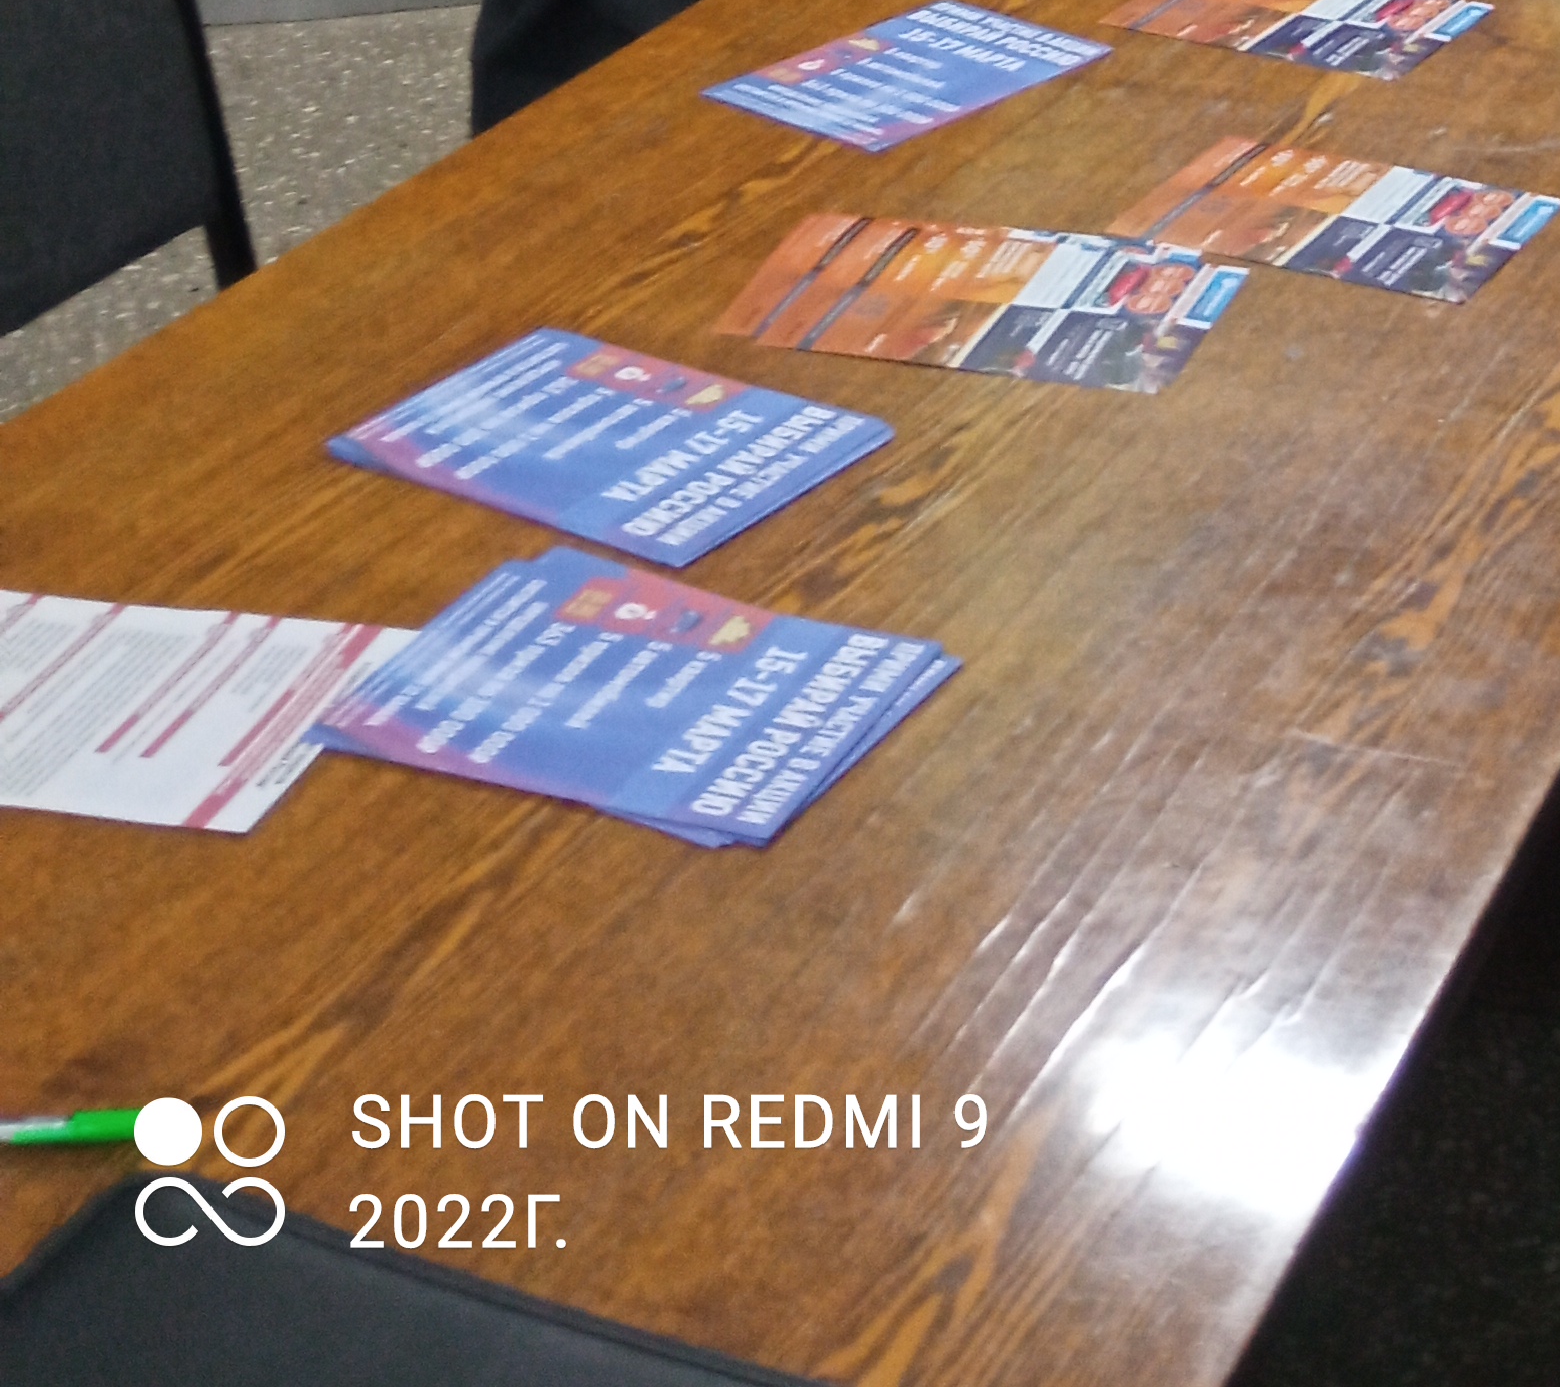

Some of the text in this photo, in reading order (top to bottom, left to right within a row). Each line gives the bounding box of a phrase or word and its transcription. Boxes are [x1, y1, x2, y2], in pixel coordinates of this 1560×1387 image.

[898, 29, 965, 50] 15-17
[953, 46, 1025, 71] МАРТА
[685, 410, 763, 454] 15-17
[717, 406, 836, 475] ВЫБИРАЙ
[602, 450, 700, 501] МАРТА
[622, 472, 735, 536] РОССИЮ
[653, 647, 807, 772] 15-17 МАРТА
[691, 634, 888, 816] ВЫБИРАЙ РОССИЮ
[800, 696, 877, 757] УЧАСТИЕ
[788, 758, 820, 770] В
[737, 770, 807, 824] АКЦИИ
